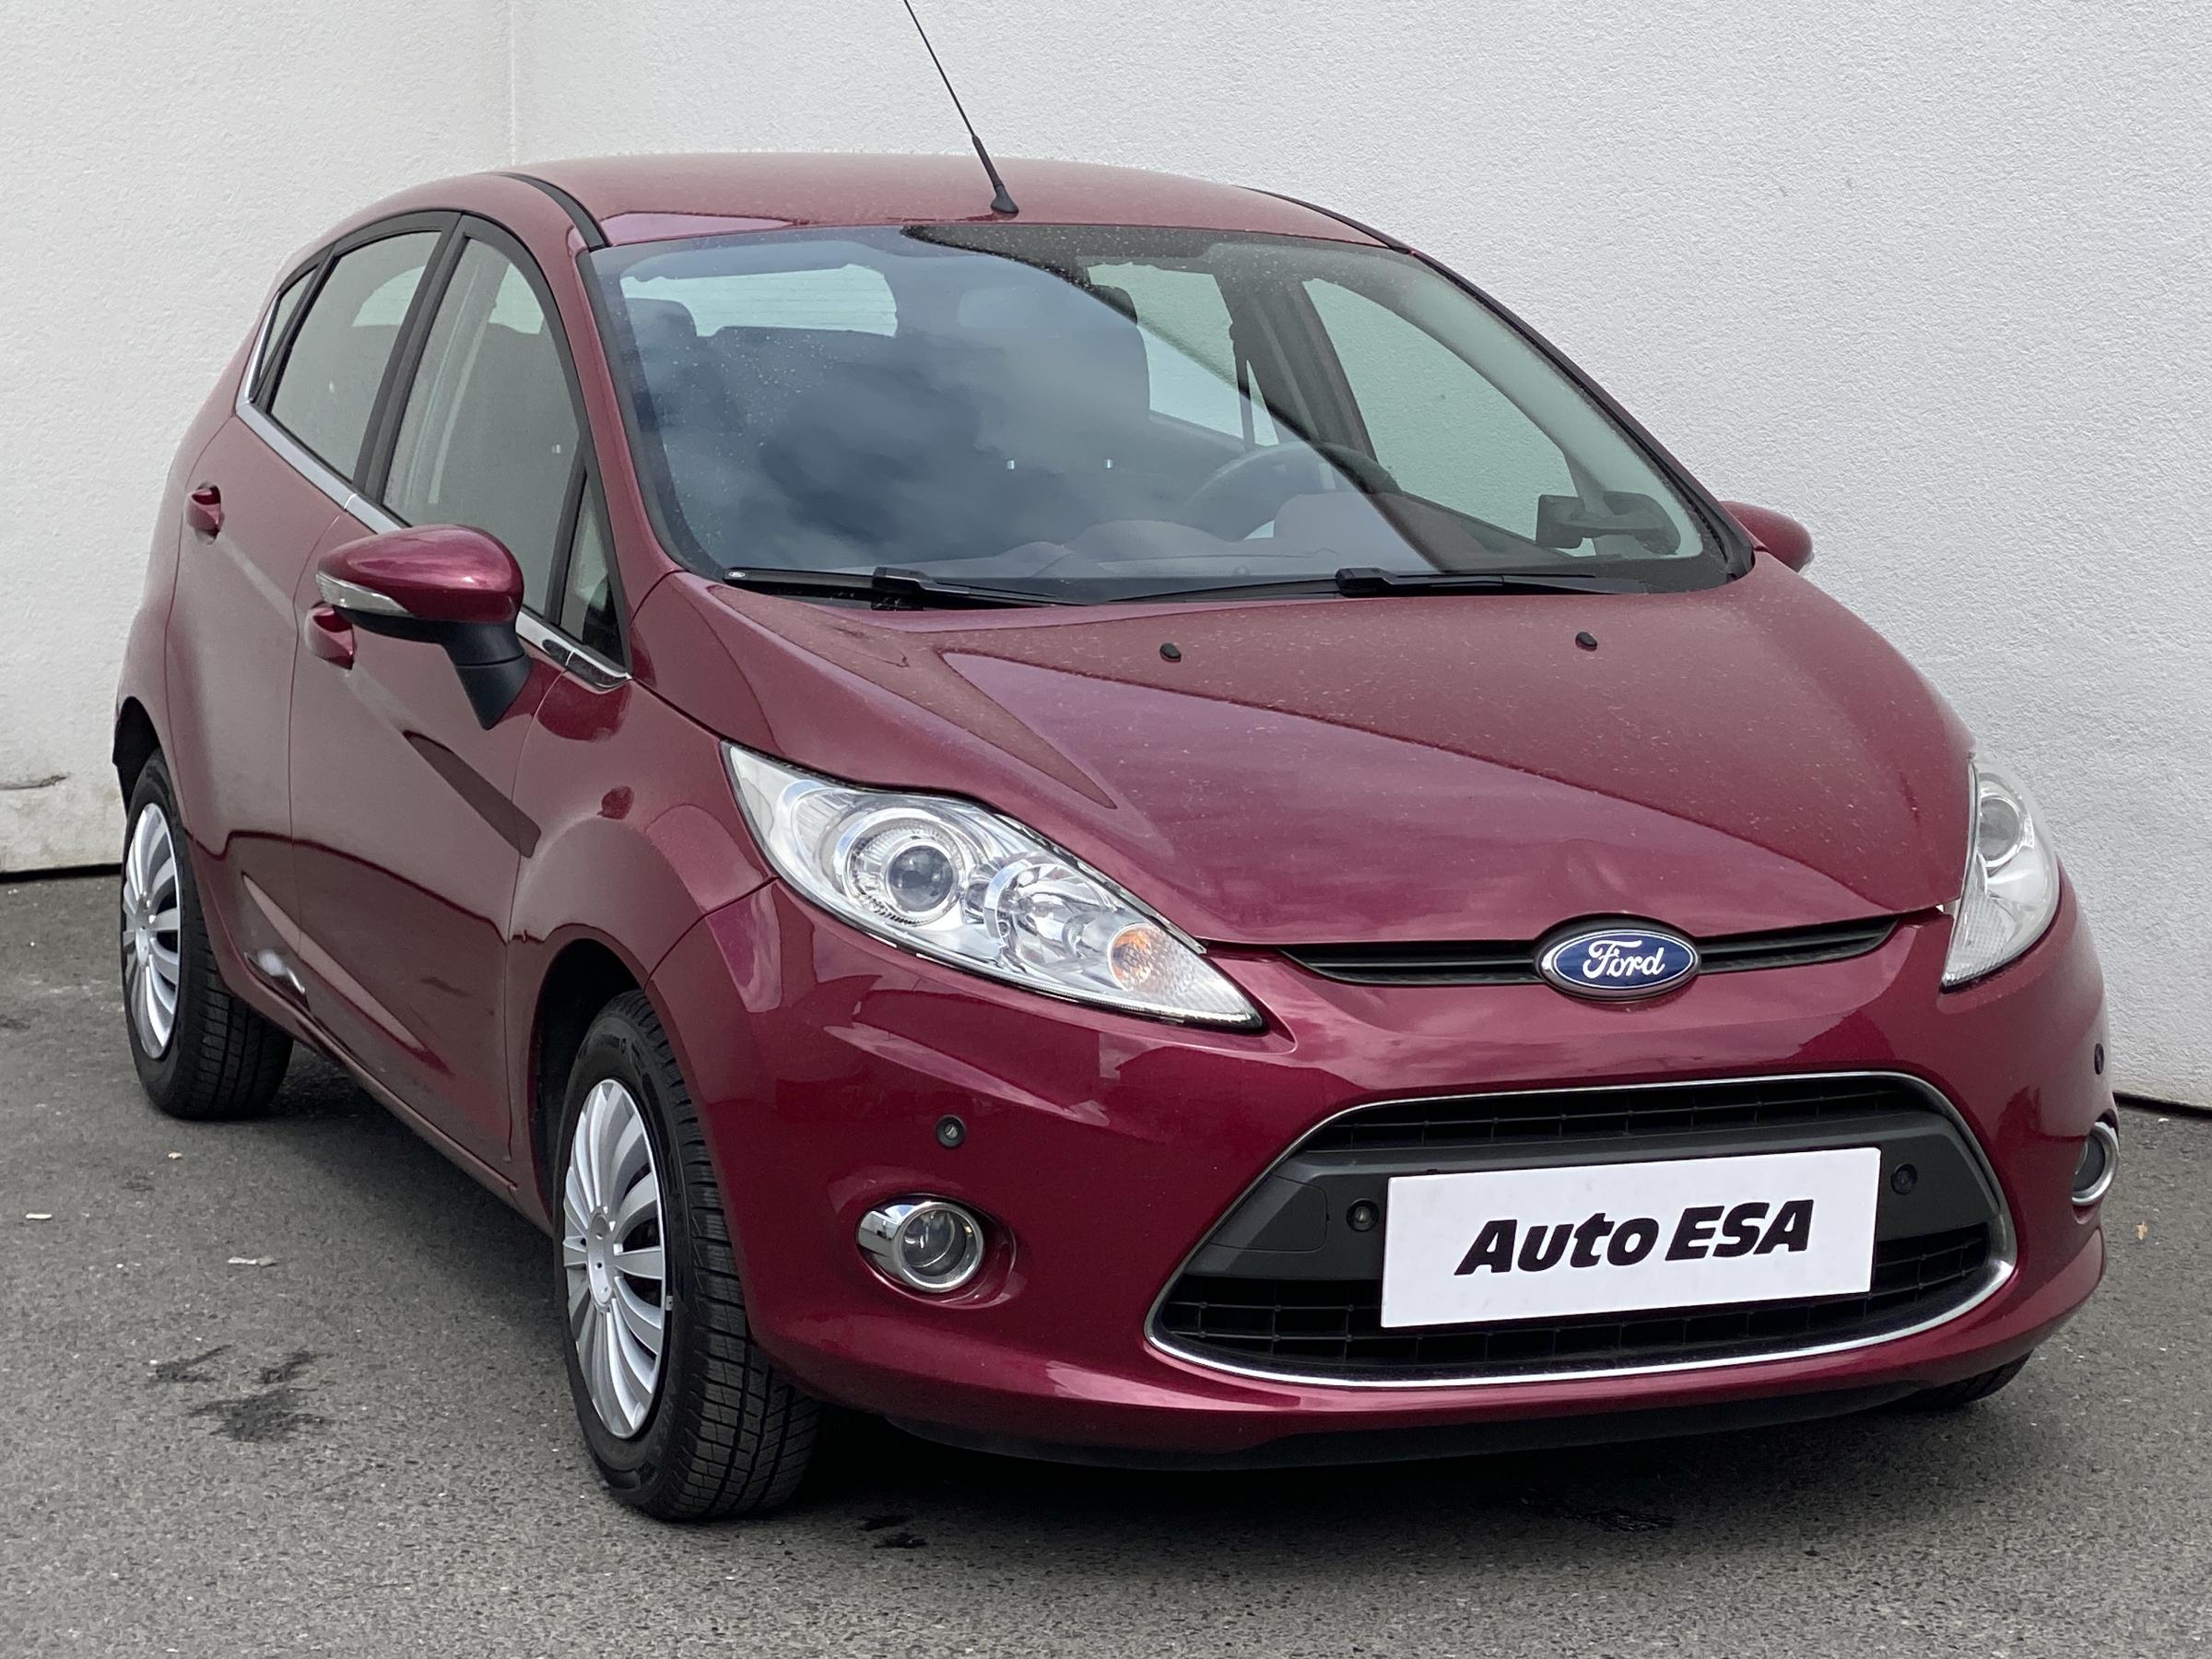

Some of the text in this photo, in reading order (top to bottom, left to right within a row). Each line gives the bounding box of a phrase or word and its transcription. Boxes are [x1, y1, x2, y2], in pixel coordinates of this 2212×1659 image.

[1583, 939, 1665, 979] Ford
[1454, 1199, 1815, 1277] Auto ESA
